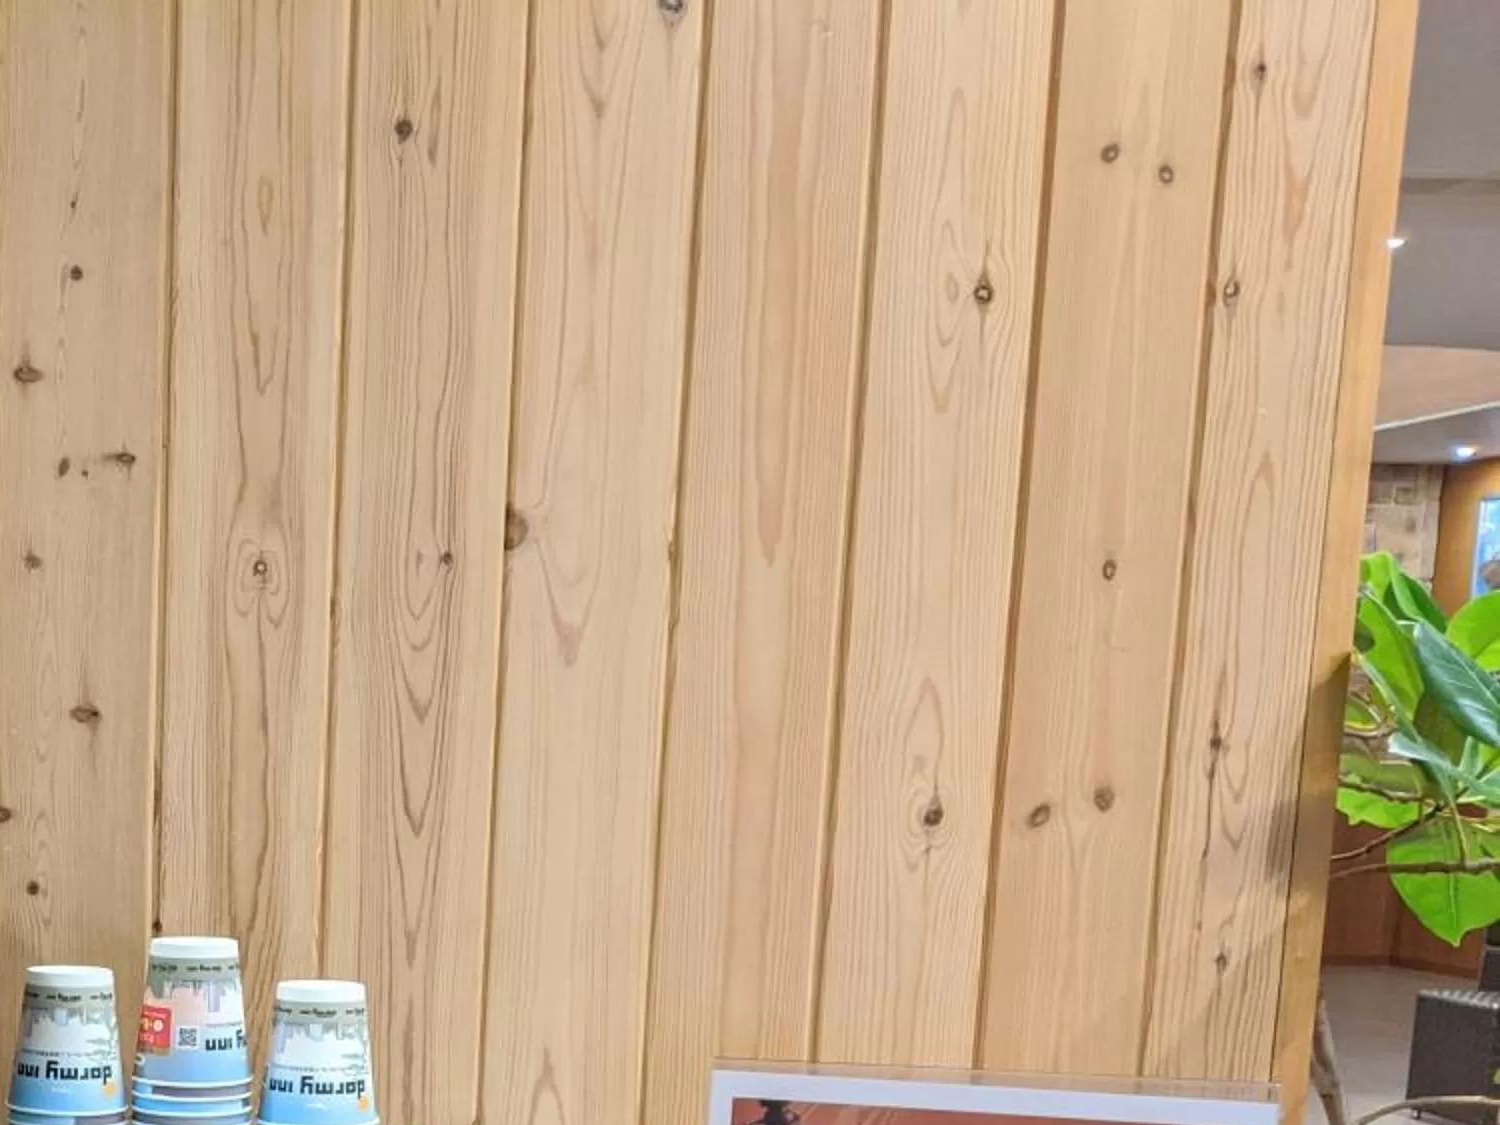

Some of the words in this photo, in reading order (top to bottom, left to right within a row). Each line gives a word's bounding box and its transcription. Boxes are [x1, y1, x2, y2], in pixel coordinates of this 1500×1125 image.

[16, 1063, 40, 1080] inn
[46, 1061, 112, 1084] dormy
[269, 1079, 294, 1093] inn
[299, 1076, 366, 1098] dormy
